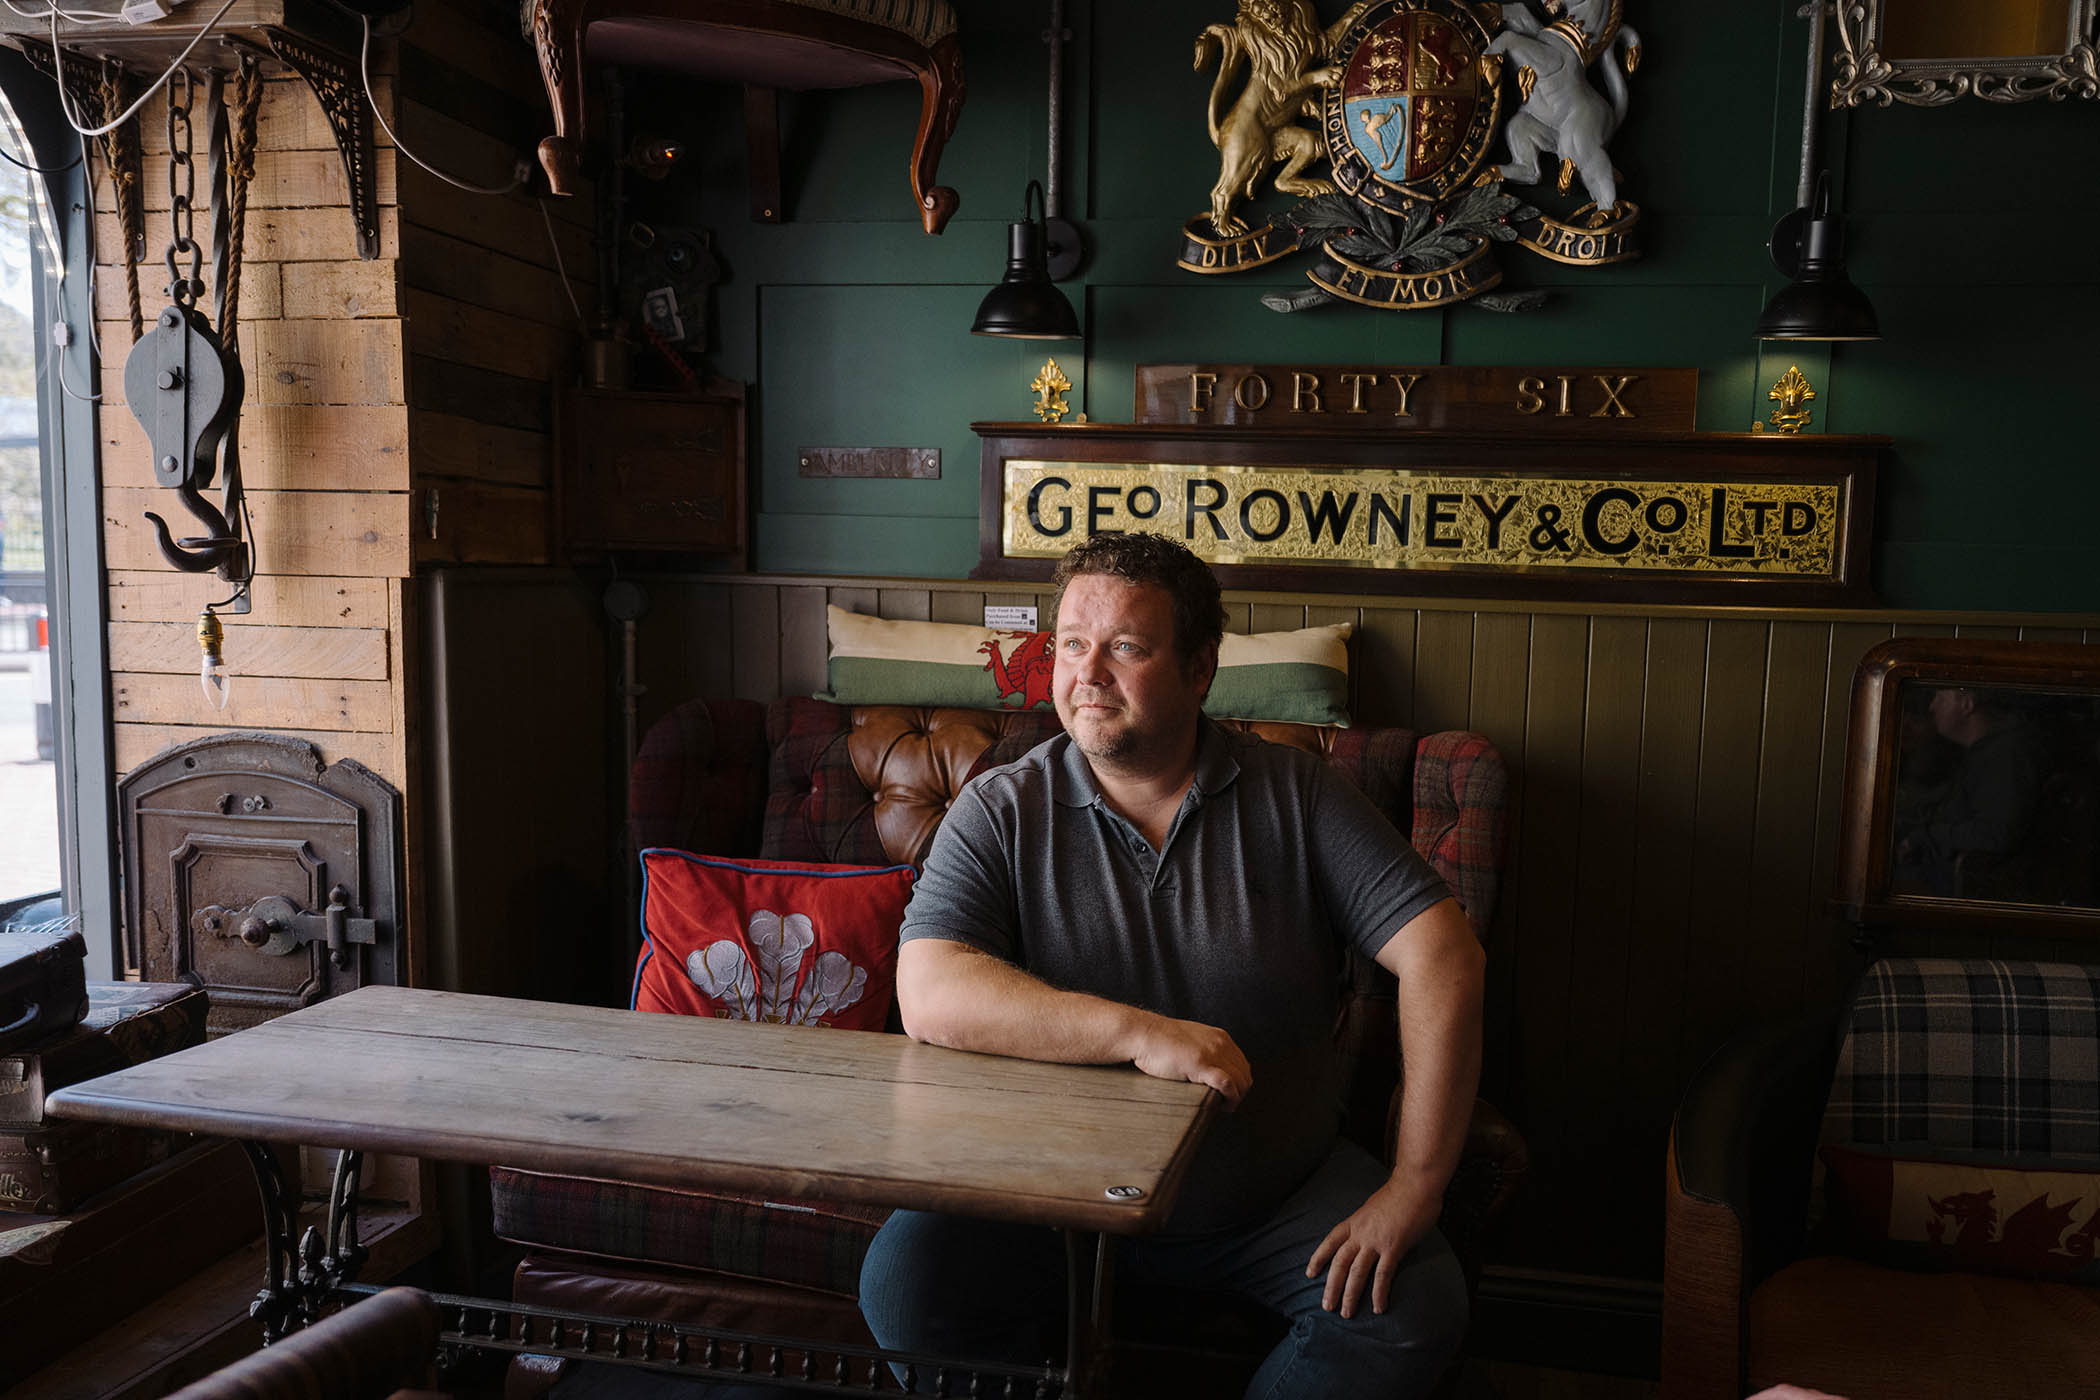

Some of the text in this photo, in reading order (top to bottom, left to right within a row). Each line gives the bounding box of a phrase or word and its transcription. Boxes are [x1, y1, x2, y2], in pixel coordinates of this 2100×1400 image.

[1188, 372, 1639, 418] FORTY SIX
[1185, 478, 1522, 550] ROWNEY
